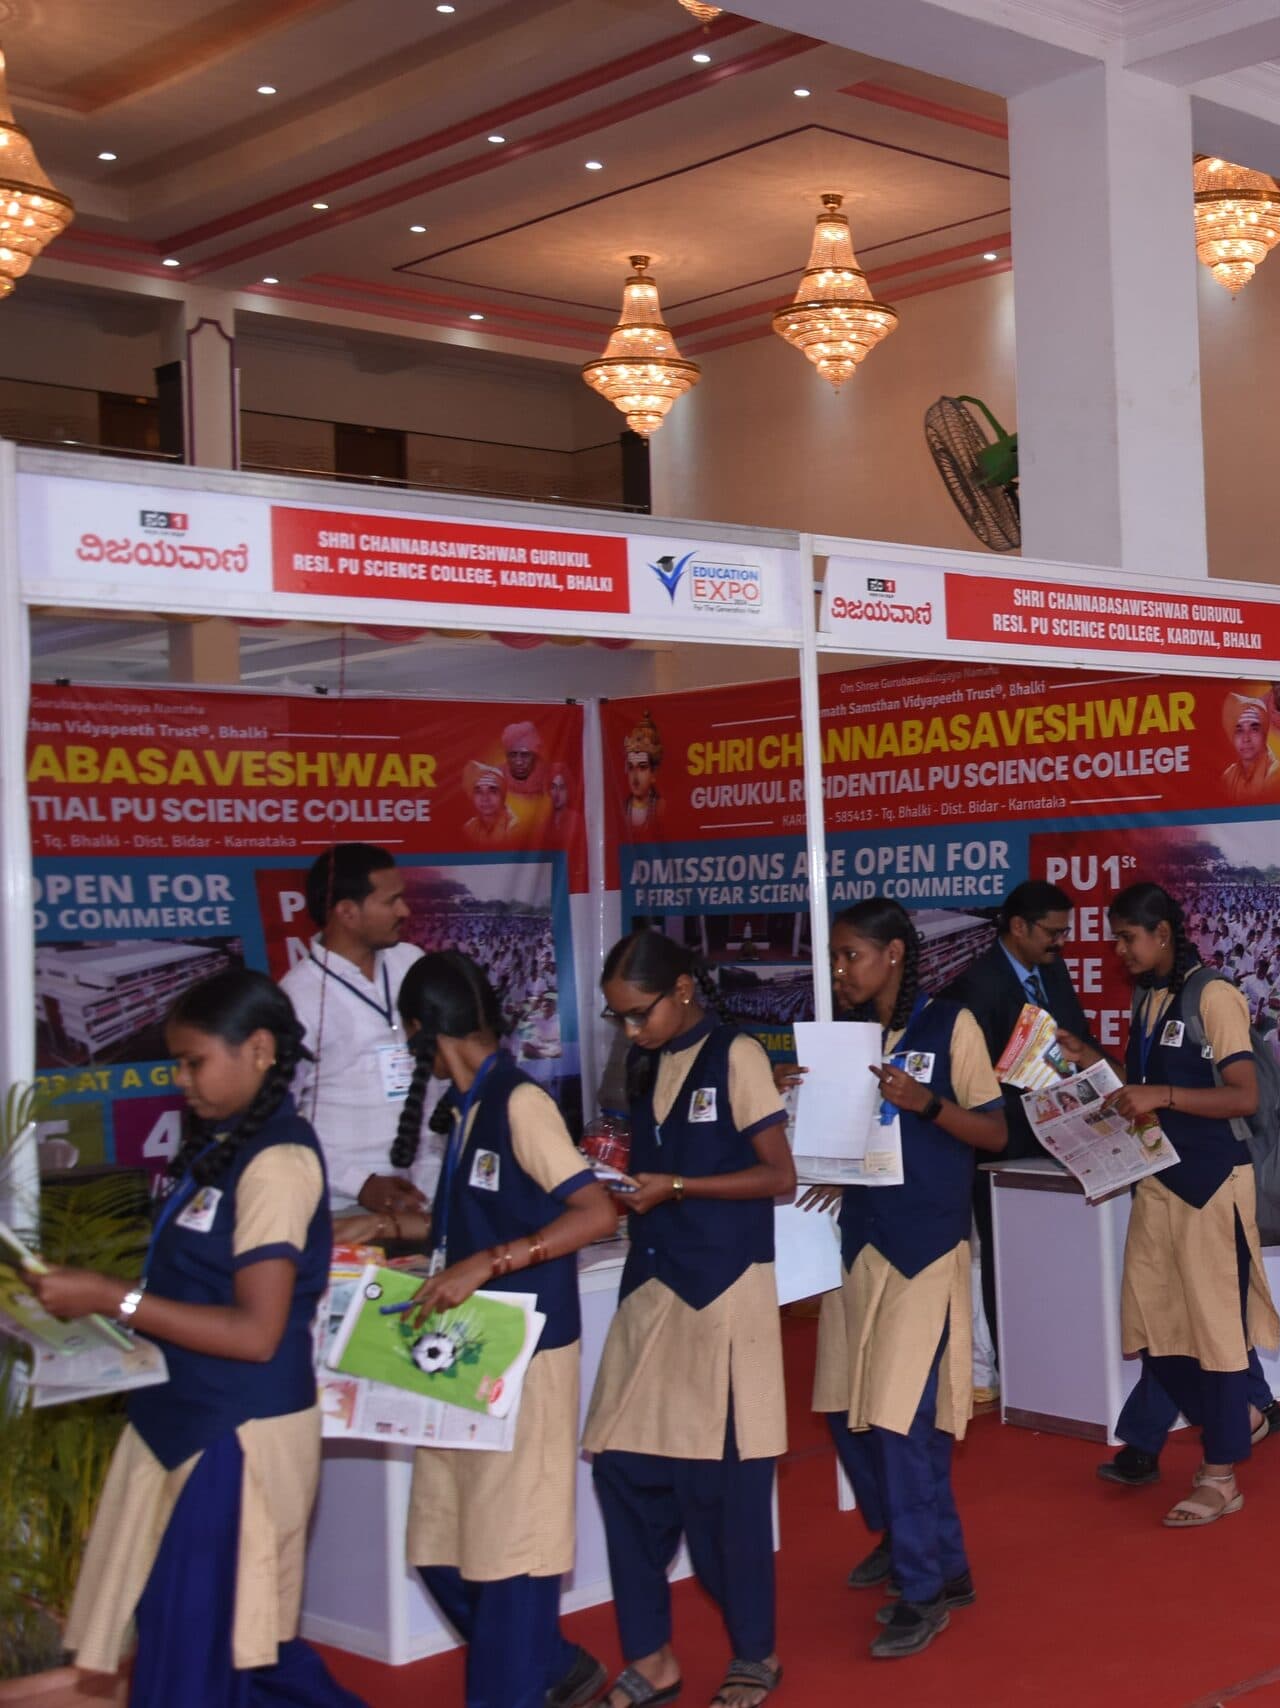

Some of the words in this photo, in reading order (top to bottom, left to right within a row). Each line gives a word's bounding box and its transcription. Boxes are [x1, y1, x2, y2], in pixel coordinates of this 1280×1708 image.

[77, 533, 249, 573] ವಿಜಯವಾಣಿ
[318, 530, 356, 550] SHRI
[359, 533, 527, 565] CHANNABASAWESHWAR
[530, 549, 592, 569] GURUKUL
[293, 553, 336, 575] RESI.
[339, 556, 360, 576] PU
[364, 558, 428, 580] SCIENCE
[431, 564, 498, 588] COLLEGE,
[501, 570, 564, 592] KARDYAL,
[567, 573, 614, 592] BHALKI
[693, 566, 759, 582] EDUCATION
[694, 580, 760, 601] EXPO
[1013, 588, 1044, 608] SHRI
[1047, 590, 1189, 620] CHANNABASAWESHWAR
[1192, 605, 1244, 624] GURUKUL
[831, 597, 933, 625] ವಿಜಯವಾಣಿ
[992, 614, 1027, 634] RESI.
[1030, 616, 1048, 635] PU
[1051, 618, 1105, 640] SCIENCE
[1108, 623, 1165, 646] COLLEGE,
[1167, 627, 1221, 650] KARDYAL,
[1223, 632, 1262, 650] BHALKI
[849, 699, 902, 716] Samsthan
[902, 690, 964, 711] Vidyapeeth
[1009, 681, 1046, 698] Bhalki
[66, 720, 156, 739] Vidyapeeth
[219, 726, 268, 739] Bhalki
[687, 736, 754, 776] SHRI
[758, 691, 1197, 770] CHNNABASAVESHWAR
[691, 780, 784, 810] GURUKUL
[929, 765, 960, 792] PU
[964, 755, 1069, 788] SCIENCE
[1073, 744, 1191, 780] COLLEGE
[112, 797, 156, 823] PU
[161, 797, 299, 823] SCIENCE
[303, 799, 431, 823] COLLEGE
[898, 804, 931, 819] Bhalki
[941, 802, 966, 817] Dist.
[969, 800, 998, 814] Bidar
[1008, 797, 1066, 812] Karnataka
[71, 834, 120, 848] Bhalki
[172, 834, 211, 848] Bidar
[225, 835, 297, 849] Karnataka
[853, 844, 936, 875] OPEN
[946, 839, 1010, 871] FOR
[148, 874, 235, 903] FOR
[647, 888, 693, 907] FIRST
[697, 886, 744, 905] YEAR
[832, 881, 877, 901] AND
[881, 874, 1003, 899] COMMERCE
[59, 905, 231, 930] COMMERCE
